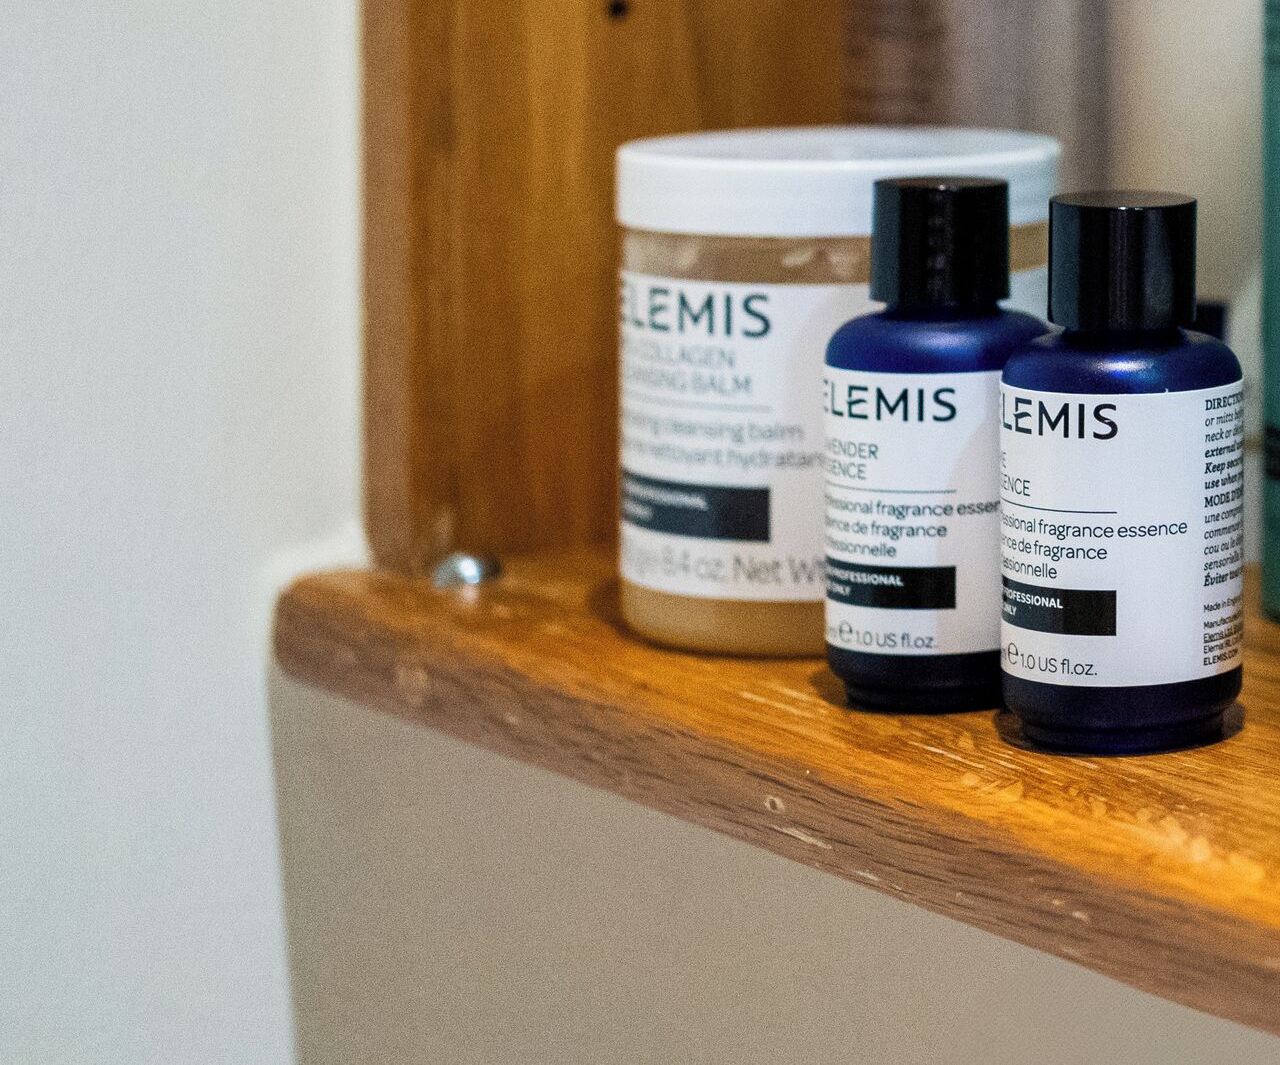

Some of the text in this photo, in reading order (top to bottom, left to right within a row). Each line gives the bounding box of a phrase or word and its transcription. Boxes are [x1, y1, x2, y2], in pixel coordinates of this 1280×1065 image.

[1001, 392, 1119, 441] LEMIS
[1204, 417, 1215, 427] or
[1204, 428, 1225, 442] neck
[827, 437, 879, 460] ENDER
[1204, 460, 1226, 475] Keep
[1204, 479, 1220, 490] use
[1204, 491, 1230, 508] MODE
[876, 500, 954, 520] fragrance
[852, 521, 868, 534] de
[871, 522, 948, 542] fragrance
[1037, 518, 1115, 541] fragrance
[1117, 522, 1188, 539] essence
[1017, 538, 1033, 554] de
[1033, 540, 1108, 562] fragrance
[1204, 541, 1220, 556] cou
[1203, 568, 1229, 587] Éviter
[1203, 602, 1221, 614] Made
[876, 633, 898, 647] US
[1020, 652, 1036, 670] 1.0
[1038, 656, 1058, 673] US
